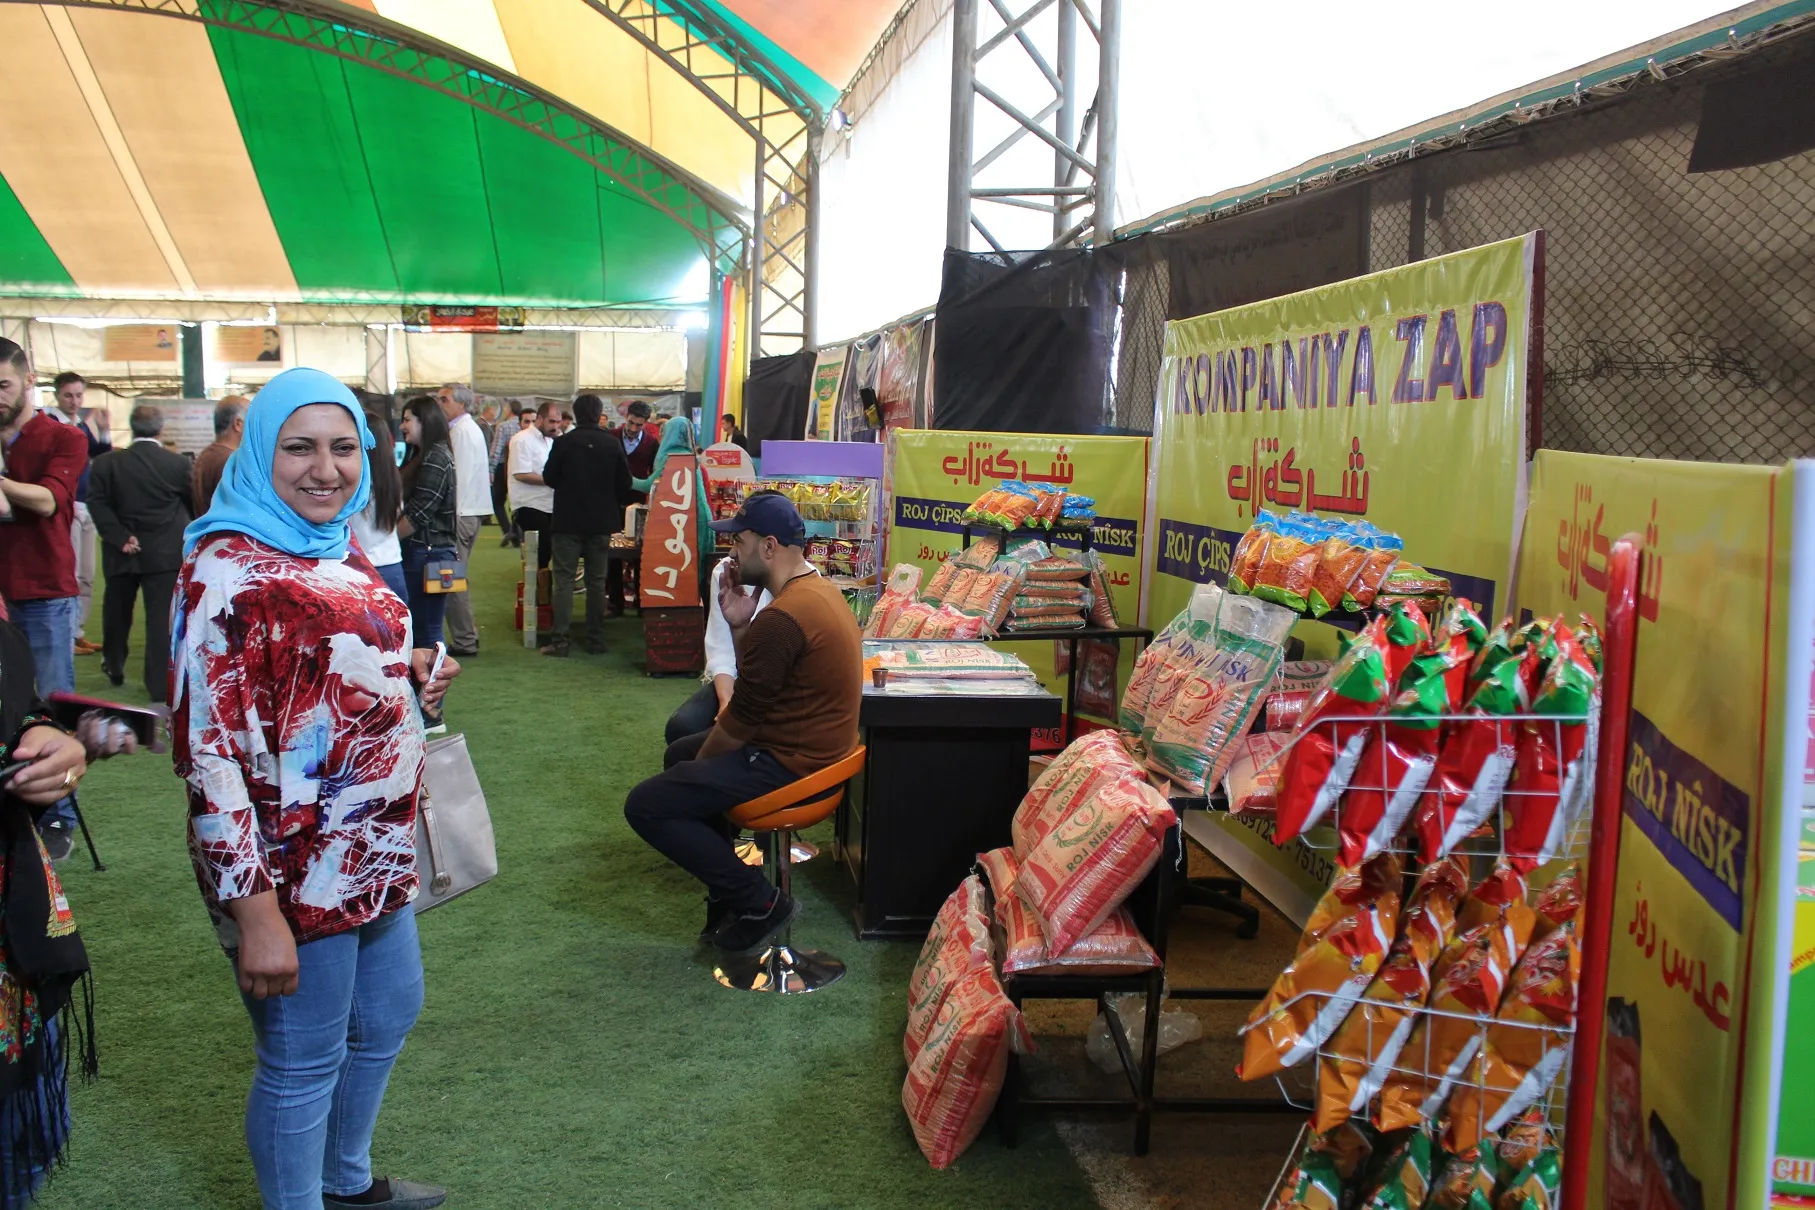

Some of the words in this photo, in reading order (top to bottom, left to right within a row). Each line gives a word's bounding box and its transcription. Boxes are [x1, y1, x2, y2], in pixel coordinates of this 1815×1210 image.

[1174, 326, 1377, 416] KOMPANIYA
[1391, 301, 1507, 404] ZAP
[902, 503, 928, 521] ROJ
[1093, 522, 1134, 548] NÎSK
[1105, 567, 1131, 587] عد
[1164, 530, 1192, 564] ROJ
[1197, 531, 1231, 576] ÇÎPS
[1626, 741, 1668, 822] ROJ
[1066, 847, 1089, 872] ROJ
[1088, 822, 1115, 848] NISK
[1661, 937, 1731, 1032] عدس
